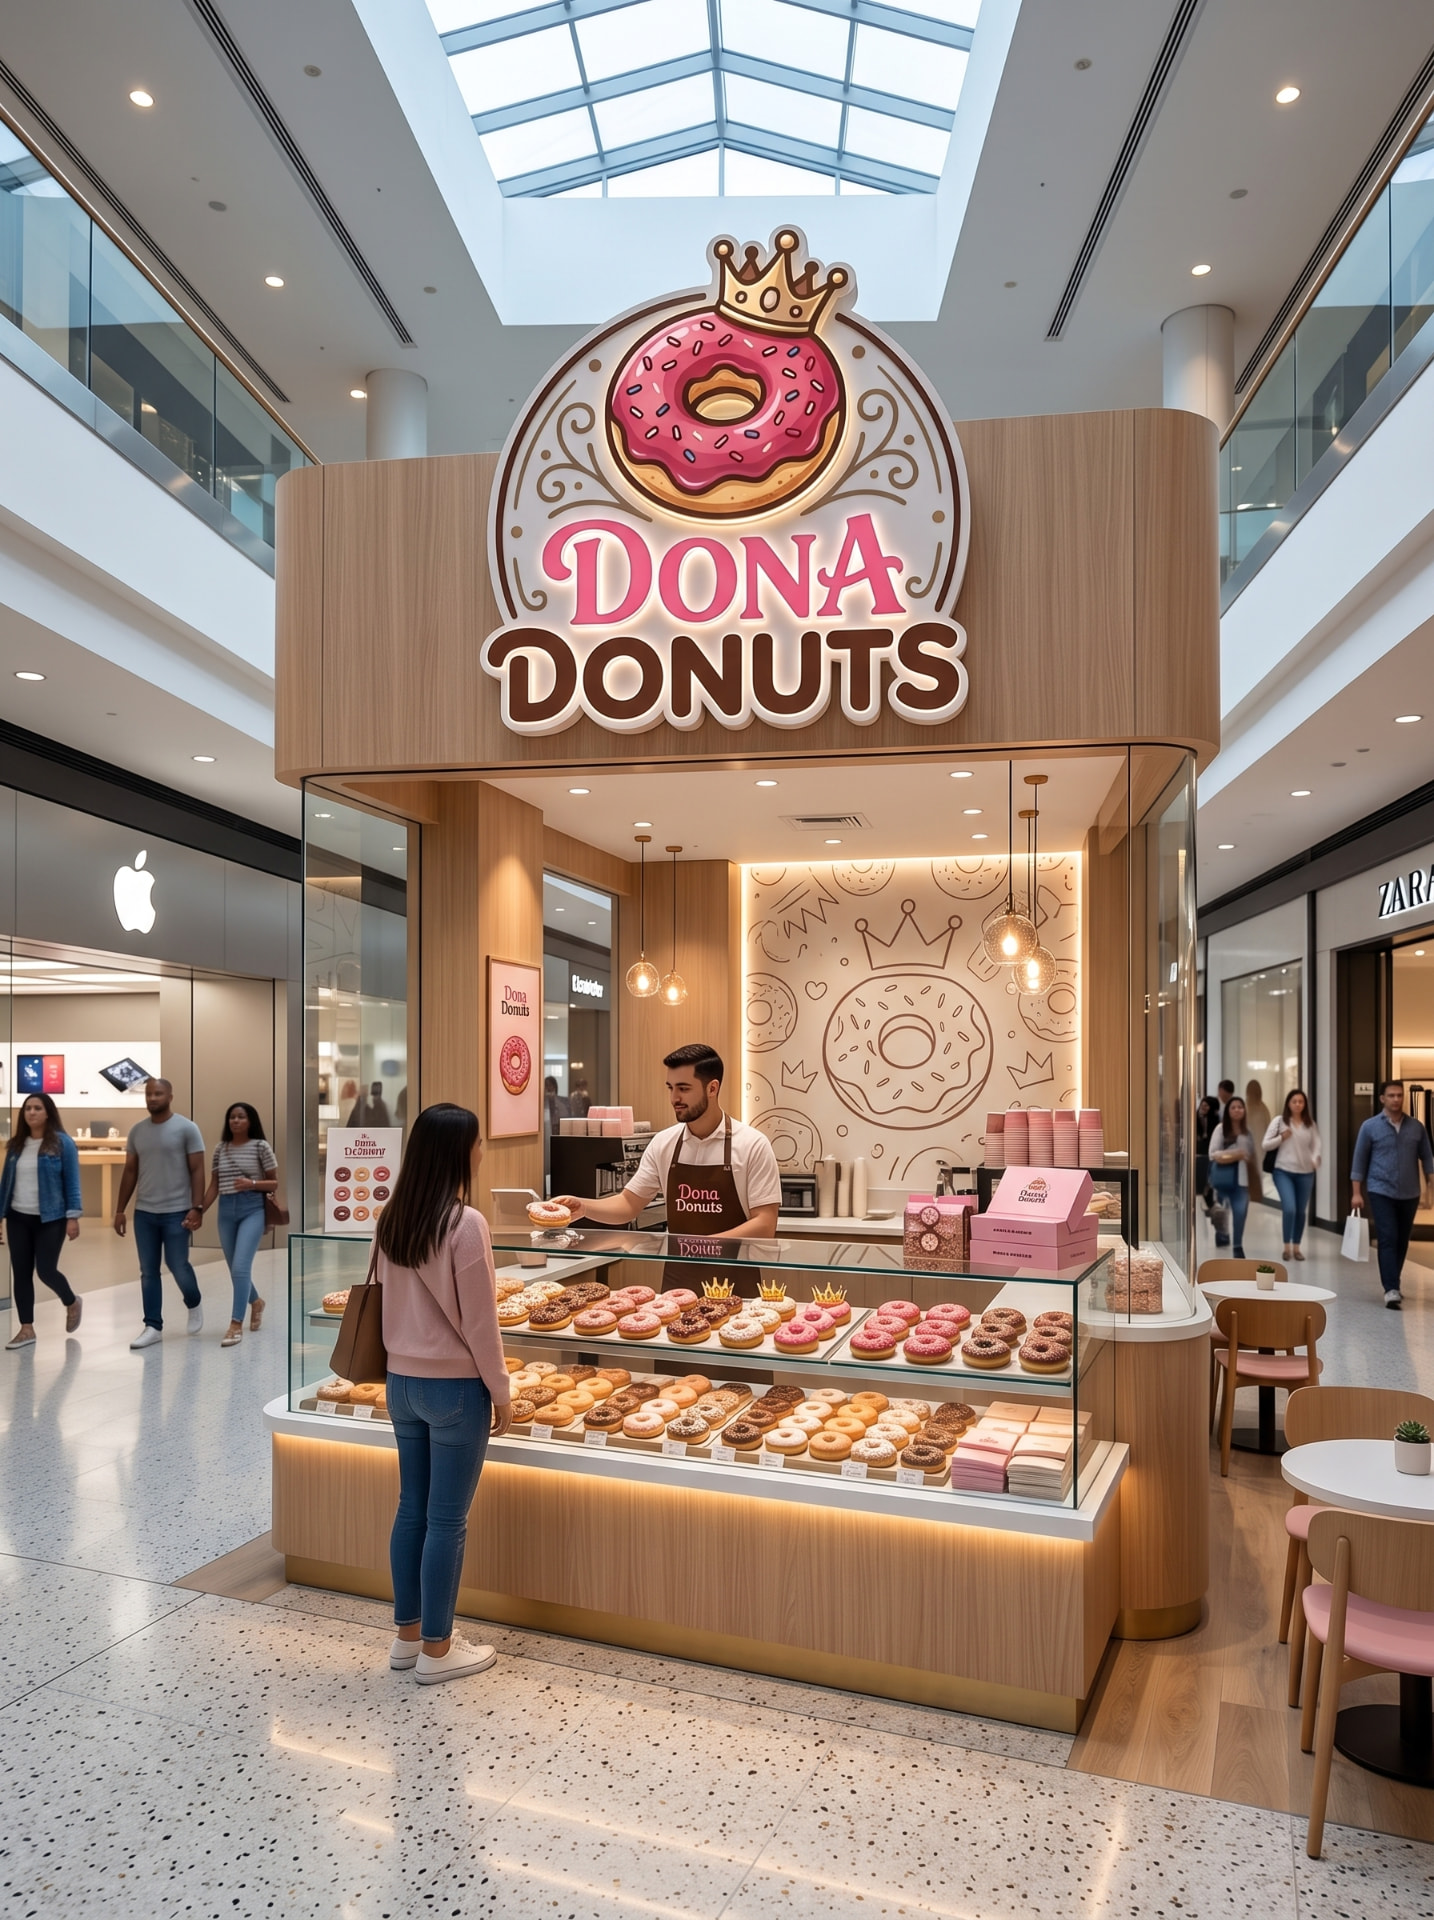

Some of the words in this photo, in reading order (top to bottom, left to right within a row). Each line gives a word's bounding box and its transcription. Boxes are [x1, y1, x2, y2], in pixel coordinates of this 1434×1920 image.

[541, 513, 907, 626] DONA
[487, 622, 961, 723] DONUTS
[504, 985, 527, 1003] Dona
[678, 1183, 720, 1200] Dona
[675, 1198, 723, 1213] Donuts
